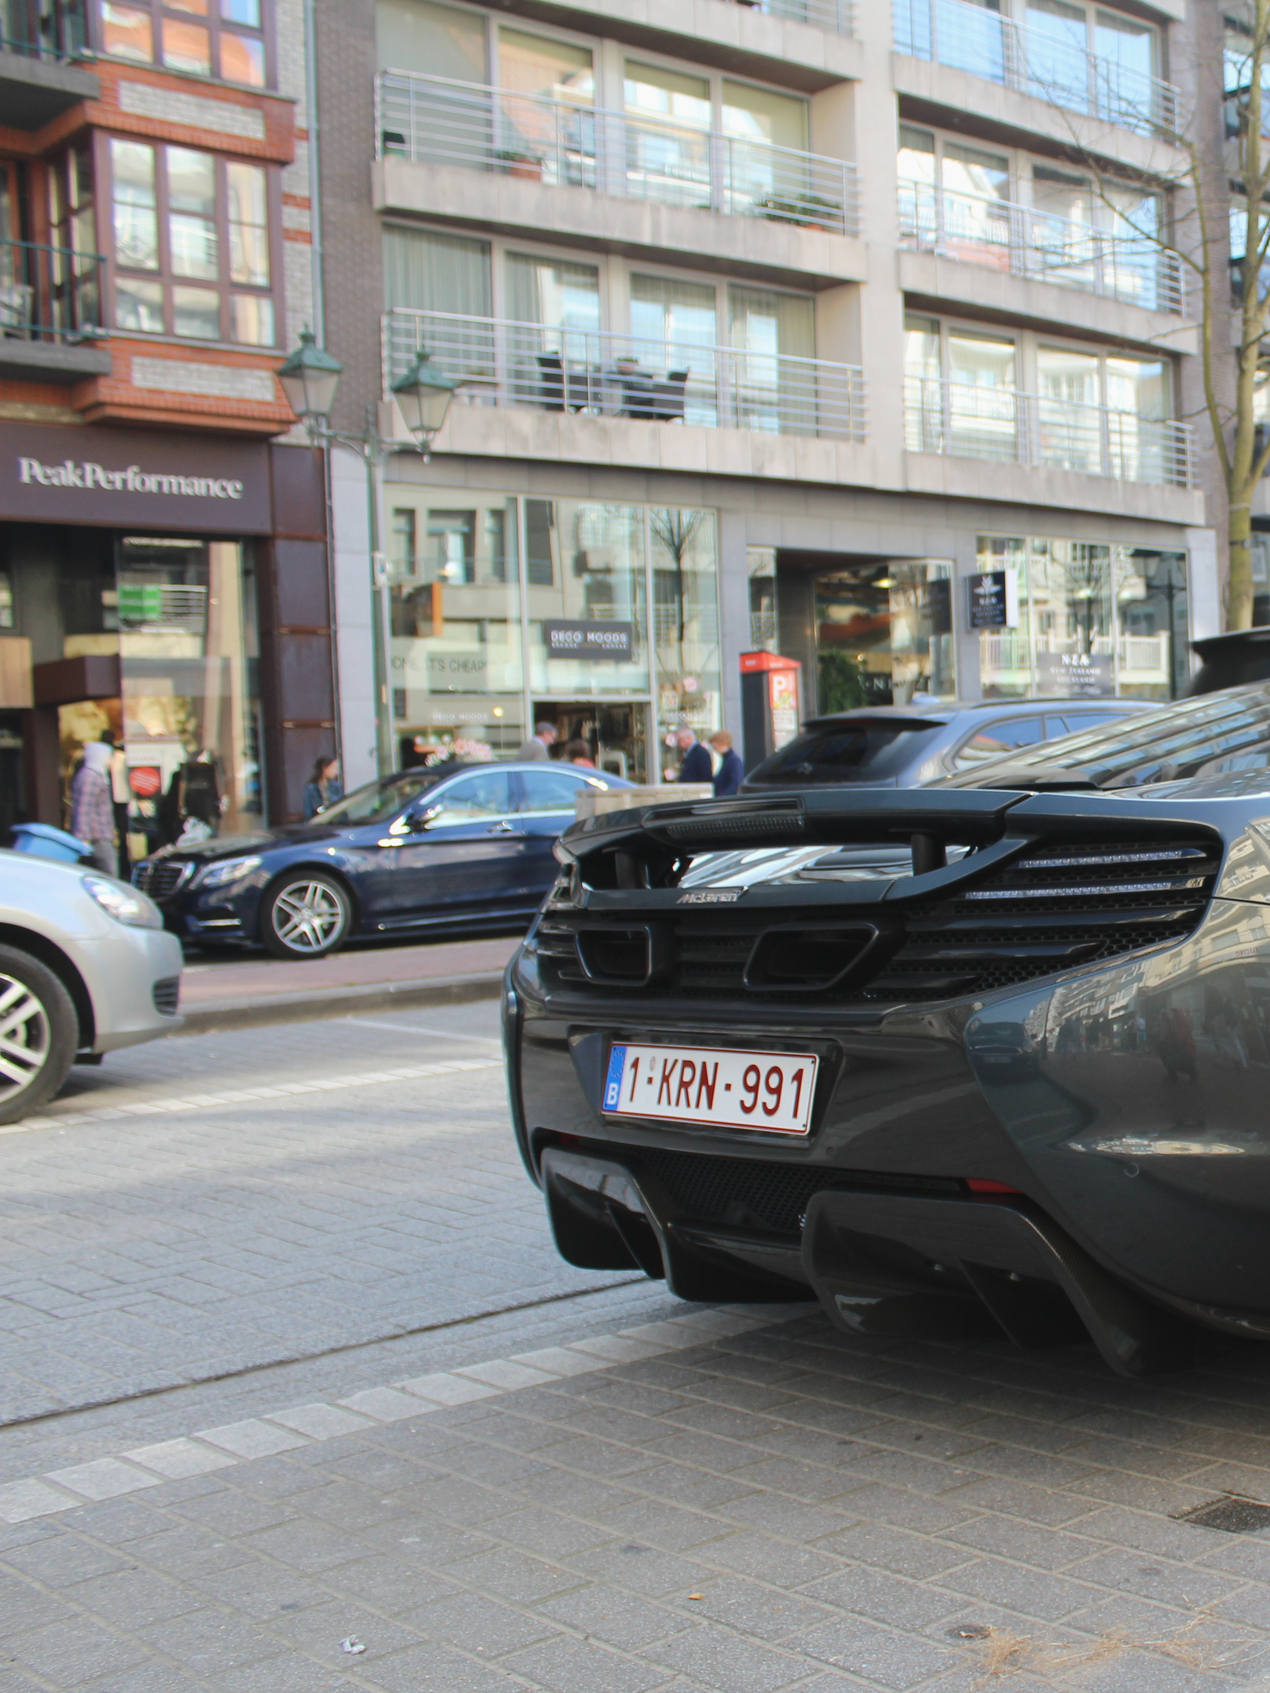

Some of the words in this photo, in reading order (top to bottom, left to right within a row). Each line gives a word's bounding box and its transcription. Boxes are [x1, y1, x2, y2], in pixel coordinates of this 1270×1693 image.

[551, 630, 583, 643] DECO
[587, 631, 629, 644] MOODS
[676, 892, 738, 904] McLaren
[607, 1082, 619, 1105] B
[629, 1056, 804, 1119] 1-KRN-991
